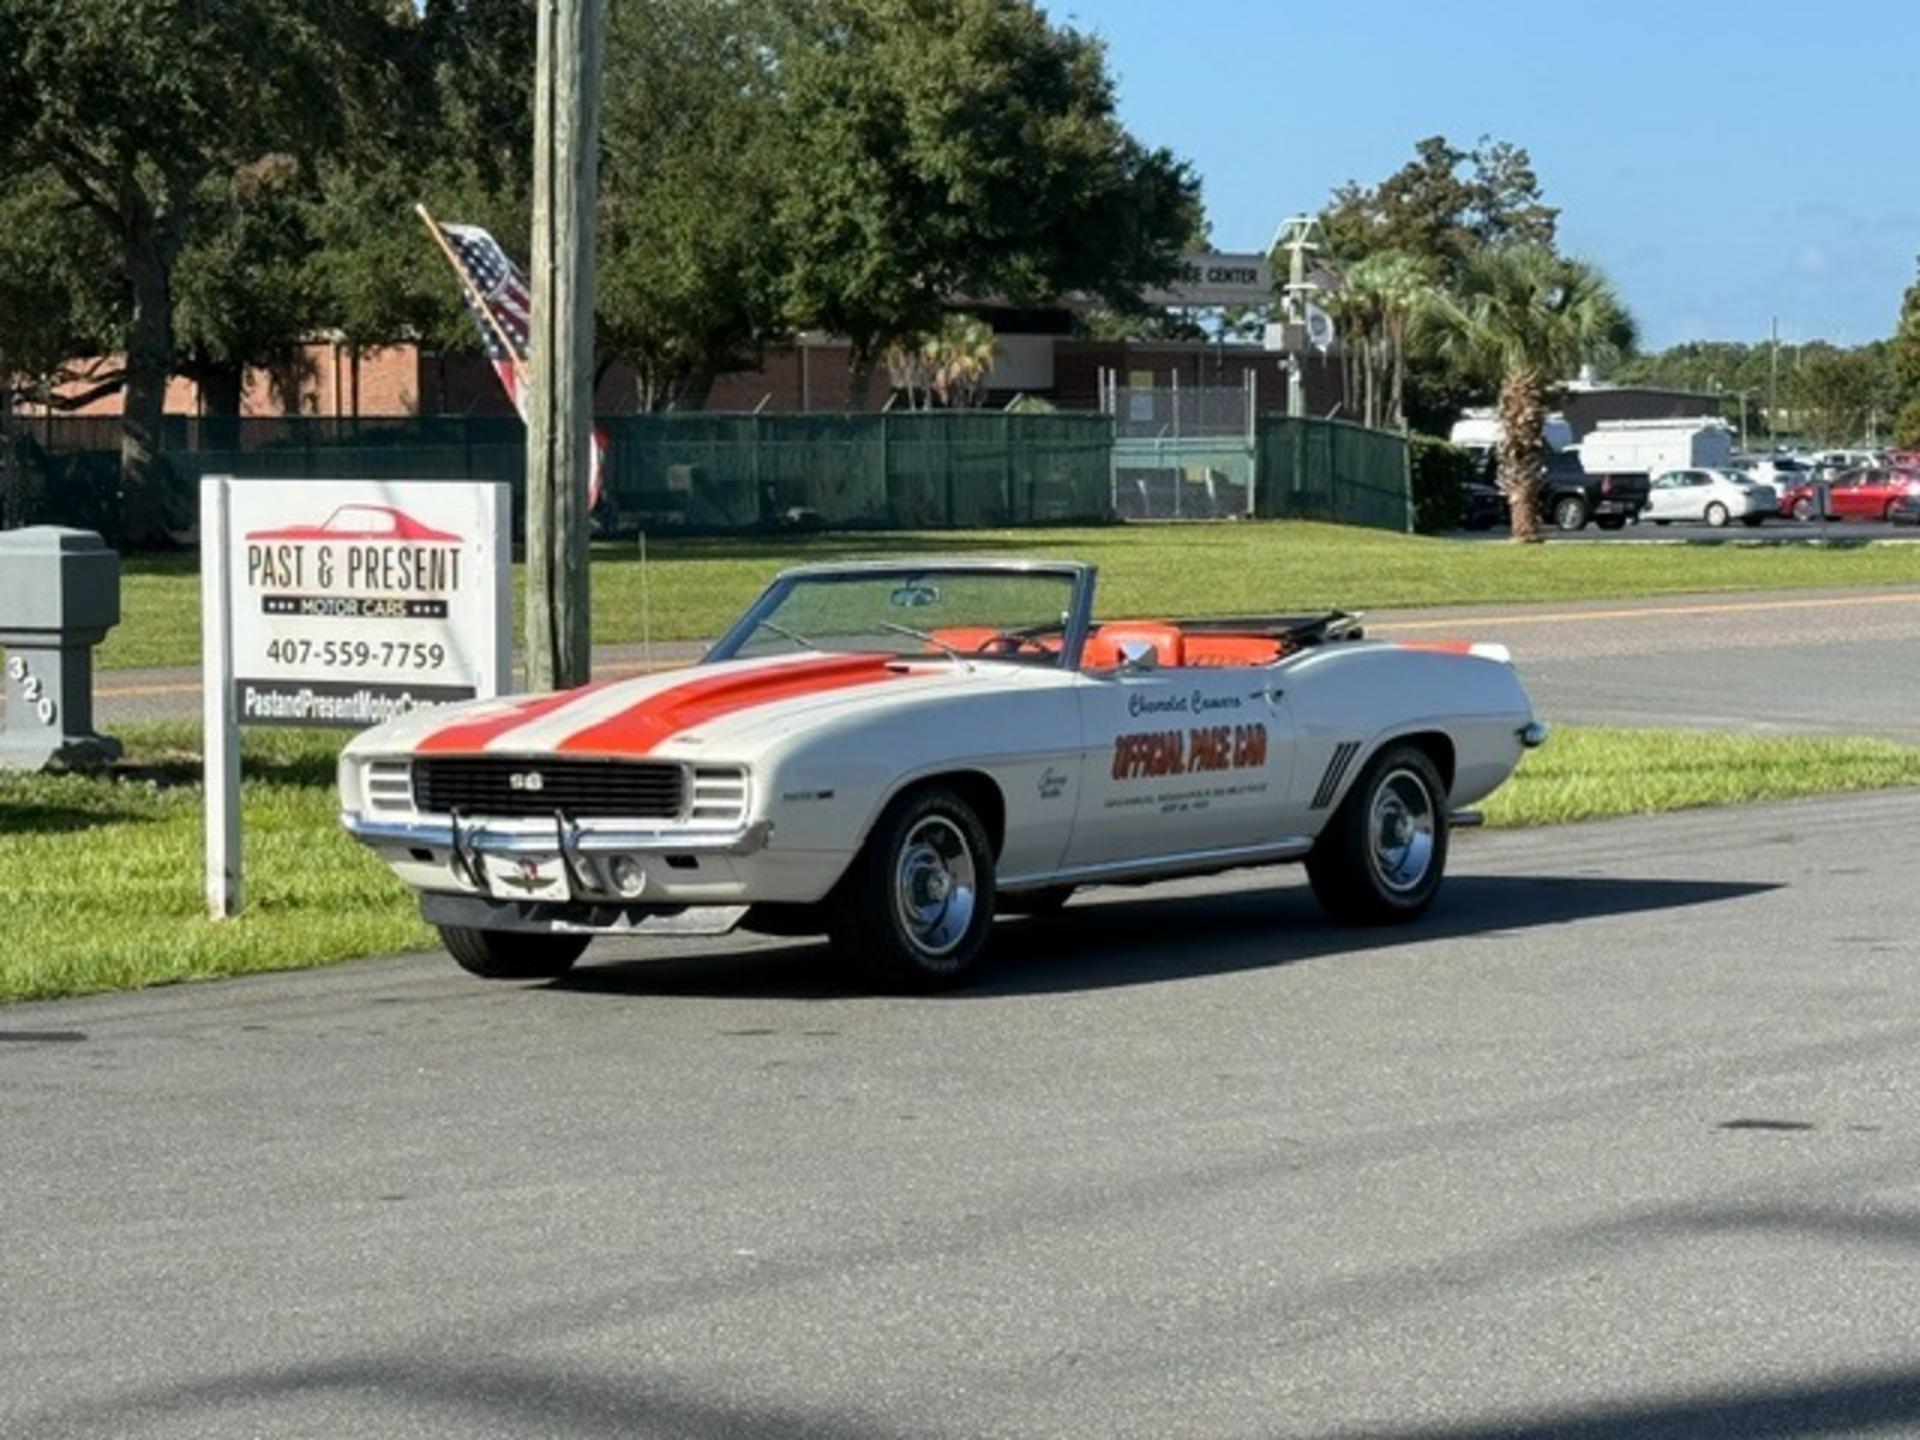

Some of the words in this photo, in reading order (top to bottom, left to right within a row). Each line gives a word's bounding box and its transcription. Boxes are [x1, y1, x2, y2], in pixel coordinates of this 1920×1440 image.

[247, 545, 304, 588] PAST
[318, 546, 333, 588] &
[348, 547, 462, 591] PRESENT
[299, 599, 358, 617] MOTOR
[361, 600, 407, 618] CARS
[267, 640, 445, 669] 407-559-7759
[8, 656, 53, 724] 320
[1111, 729, 1185, 780] OFFICIAL
[1187, 726, 1231, 773] PACE
[1232, 722, 1267, 769] CAR
